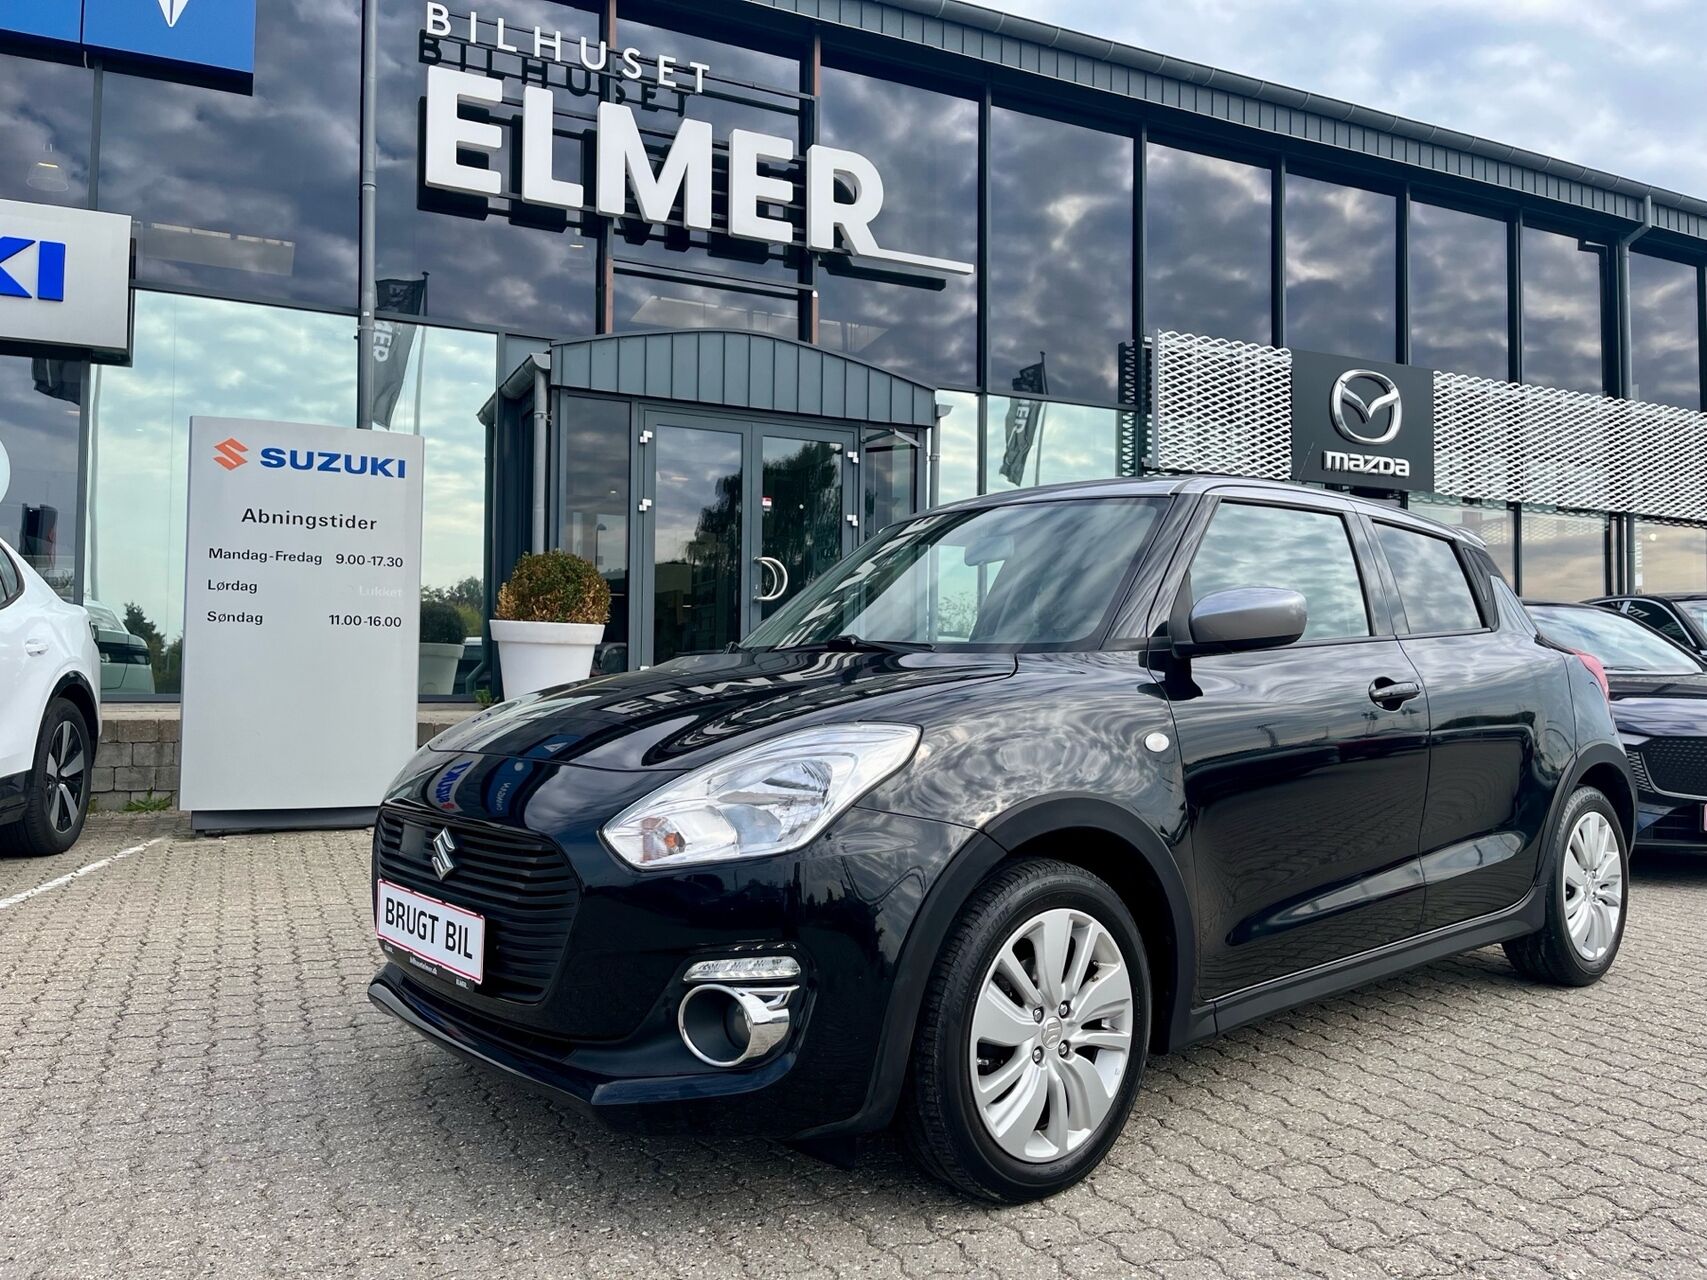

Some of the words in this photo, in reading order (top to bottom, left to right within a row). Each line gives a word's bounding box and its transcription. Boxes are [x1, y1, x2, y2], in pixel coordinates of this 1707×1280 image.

[426, 1, 710, 94] BILHUSET
[424, 64, 974, 275] ELMER
[259, 446, 407, 479] SUZUKI
[1323, 449, 1411, 478] mazda
[241, 507, 378, 531] Abningstider
[208, 547, 323, 566] Mandag-Fredag
[335, 553, 404, 568] 9.00-17.30
[207, 579, 258, 594] Lørdag
[358, 585, 404, 598] Lukket
[207, 611, 264, 626] Søndag
[328, 614, 402, 628] 11.00-16.00
[384, 896, 440, 944] BRUGT
[444, 921, 474, 961] BIL
